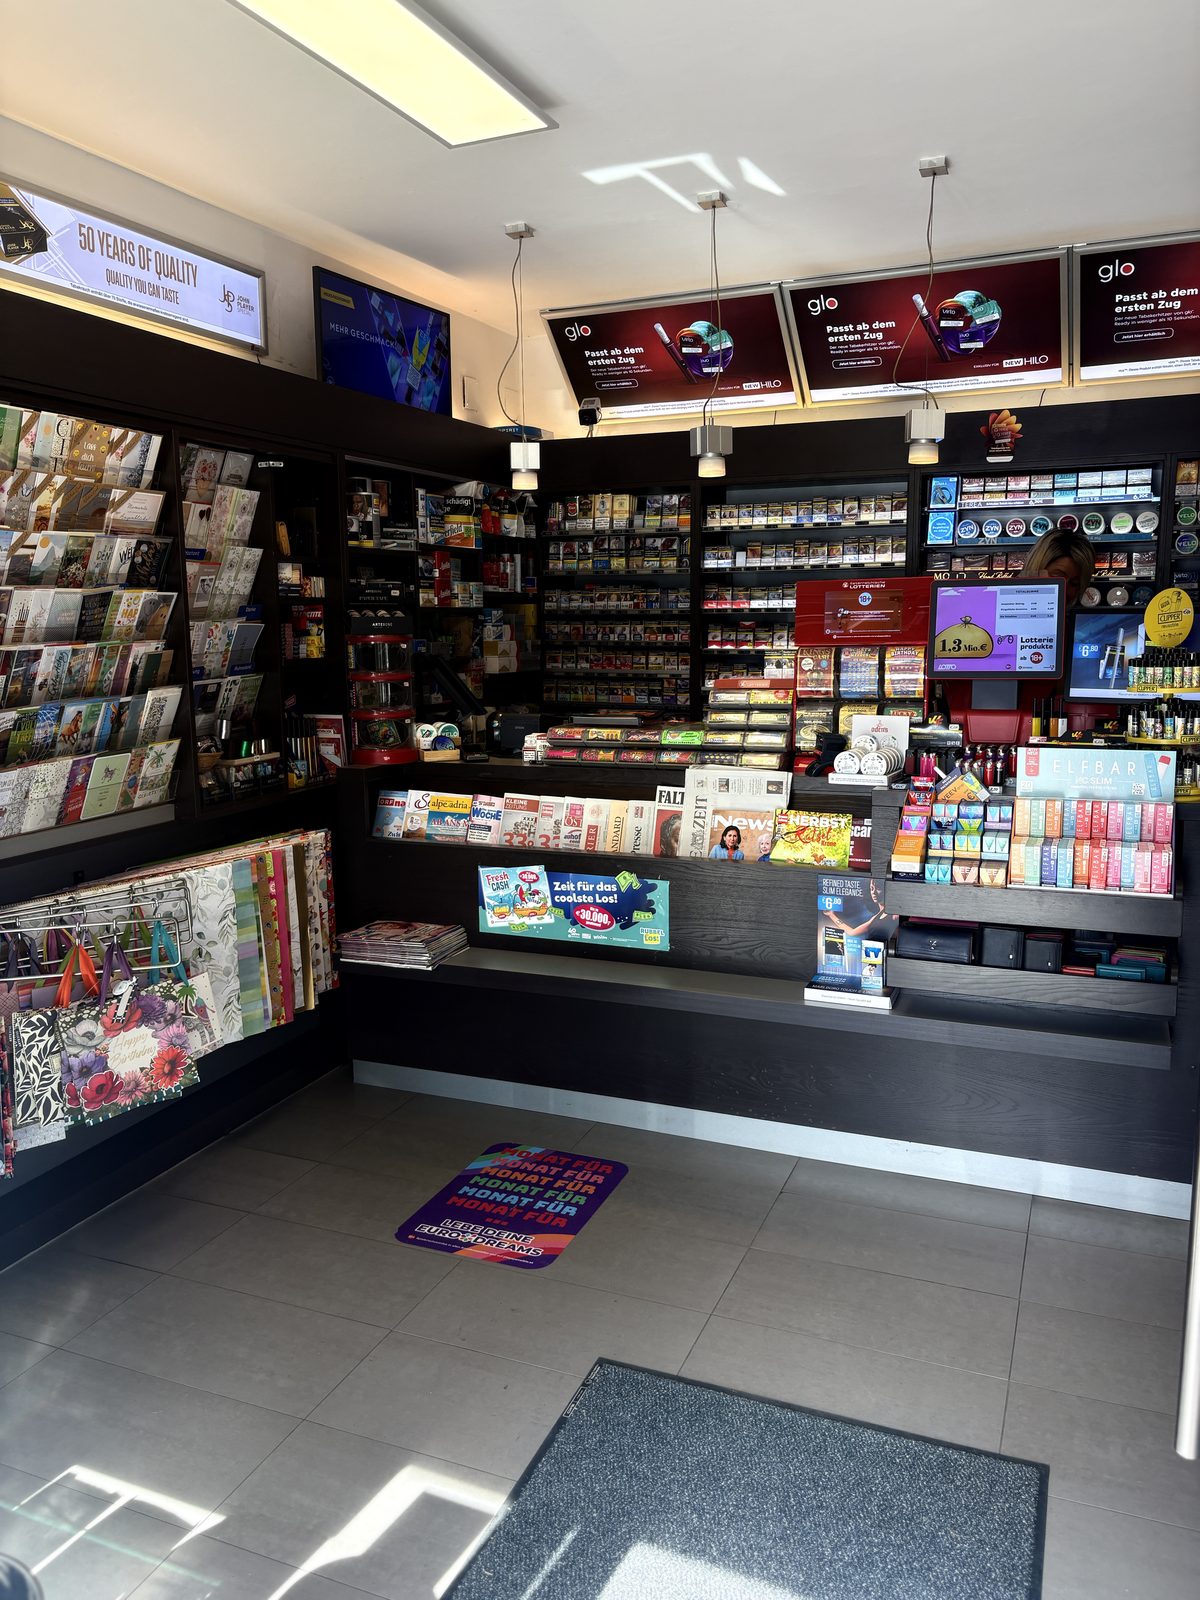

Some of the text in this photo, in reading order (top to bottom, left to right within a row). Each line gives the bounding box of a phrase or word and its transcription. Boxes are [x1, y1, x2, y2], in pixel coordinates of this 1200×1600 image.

[78, 223, 198, 288] 50 YEARS OF QUALITY
[1098, 259, 1135, 283] glo
[105, 268, 179, 305] QUALITY YOU CAN TASTE
[237, 295, 250, 304] JOHN
[1115, 288, 1198, 302] Passt ab dem
[237, 301, 255, 312] PLAYER
[807, 294, 838, 315] glo
[1115, 300, 1181, 313] ersten Zug
[329, 322, 349, 334] MEHR
[565, 322, 591, 342] glo
[826, 321, 896, 333] Passt ab dem
[828, 332, 883, 342] ersten Zug
[584, 349, 608, 357] Passt
[1024, 355, 1048, 365] HILO
[588, 356, 635, 365] ersten Zug
[760, 380, 781, 388] HILO
[446, 498, 471, 506] schädigt
[960, 525, 974, 533] ZYN
[1159, 613, 1181, 622] CLIPPER
[940, 638, 962, 653] 1,3
[1030, 654, 1043, 662] 18+
[1053, 759, 1136, 776] ELFBAR
[1090, 777, 1112, 785] SLIM
[942, 786, 958, 802] VEEV
[472, 807, 502, 821] WOCHE
[693, 796, 707, 835] ZEIT
[789, 814, 848, 828] HERBST
[430, 818, 442, 826] AB
[713, 815, 774, 831] News
[486, 871, 509, 885] Fresh
[823, 879, 844, 888] REFINED
[491, 880, 509, 891] CASH
[554, 882, 617, 892] Zeit für das
[823, 886, 863, 897] SLIM ELEGANCE.
[555, 893, 618, 904] coolste Los!
[114, 1033, 148, 1050] Happy
[111, 1046, 156, 1068] Birthday
[501, 1148, 614, 1174] MONAT FÜR
[491, 1157, 606, 1184] MONAT FÜR
[480, 1166, 597, 1195] MONAT FÜR
[468, 1176, 588, 1205] MONAT FÜR
[458, 1185, 578, 1216] MONAT FÜR
[446, 1196, 569, 1228] MONAT FÜR
[441, 1219, 535, 1244] LEBE DEINE
